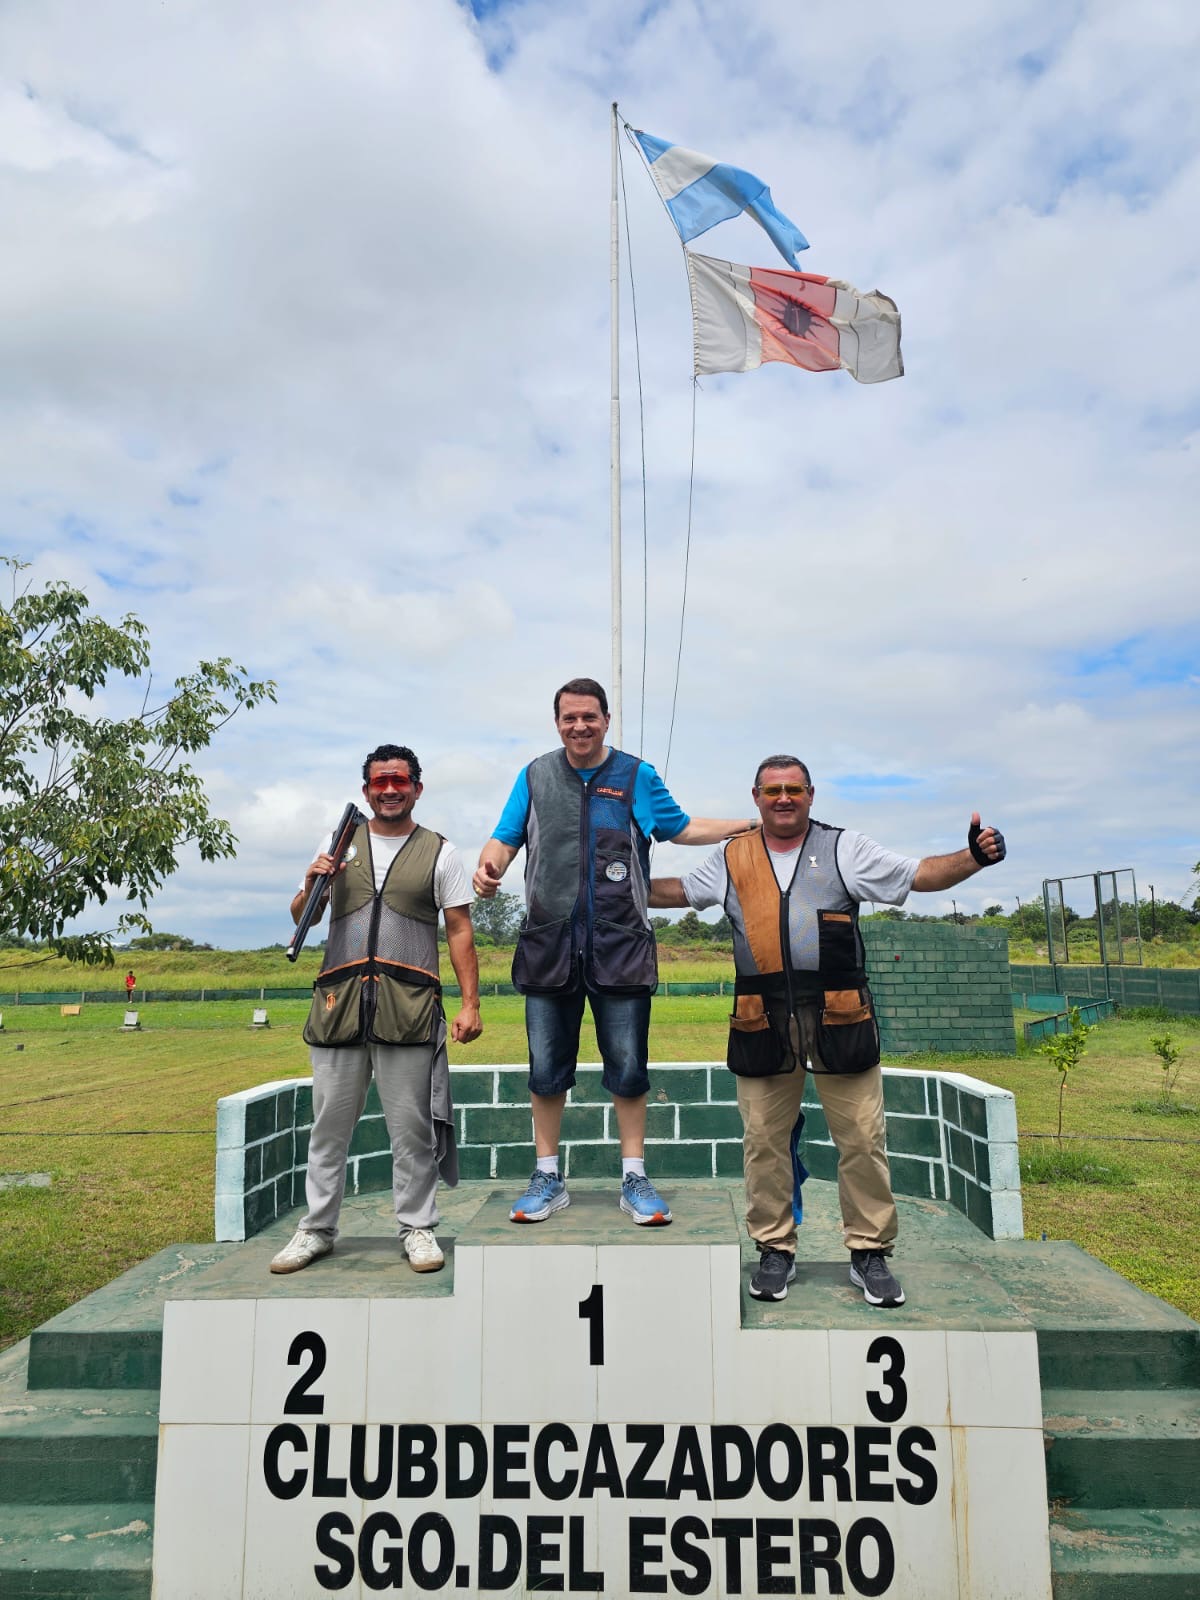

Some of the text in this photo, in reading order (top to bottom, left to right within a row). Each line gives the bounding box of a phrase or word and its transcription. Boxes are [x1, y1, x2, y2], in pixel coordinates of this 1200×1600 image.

[578, 1284, 605, 1366] 1
[283, 1330, 327, 1415] 2
[866, 1335, 908, 1423] 3
[478, 1514, 605, 1592] DEL
[629, 1516, 894, 1597] ESTERO
